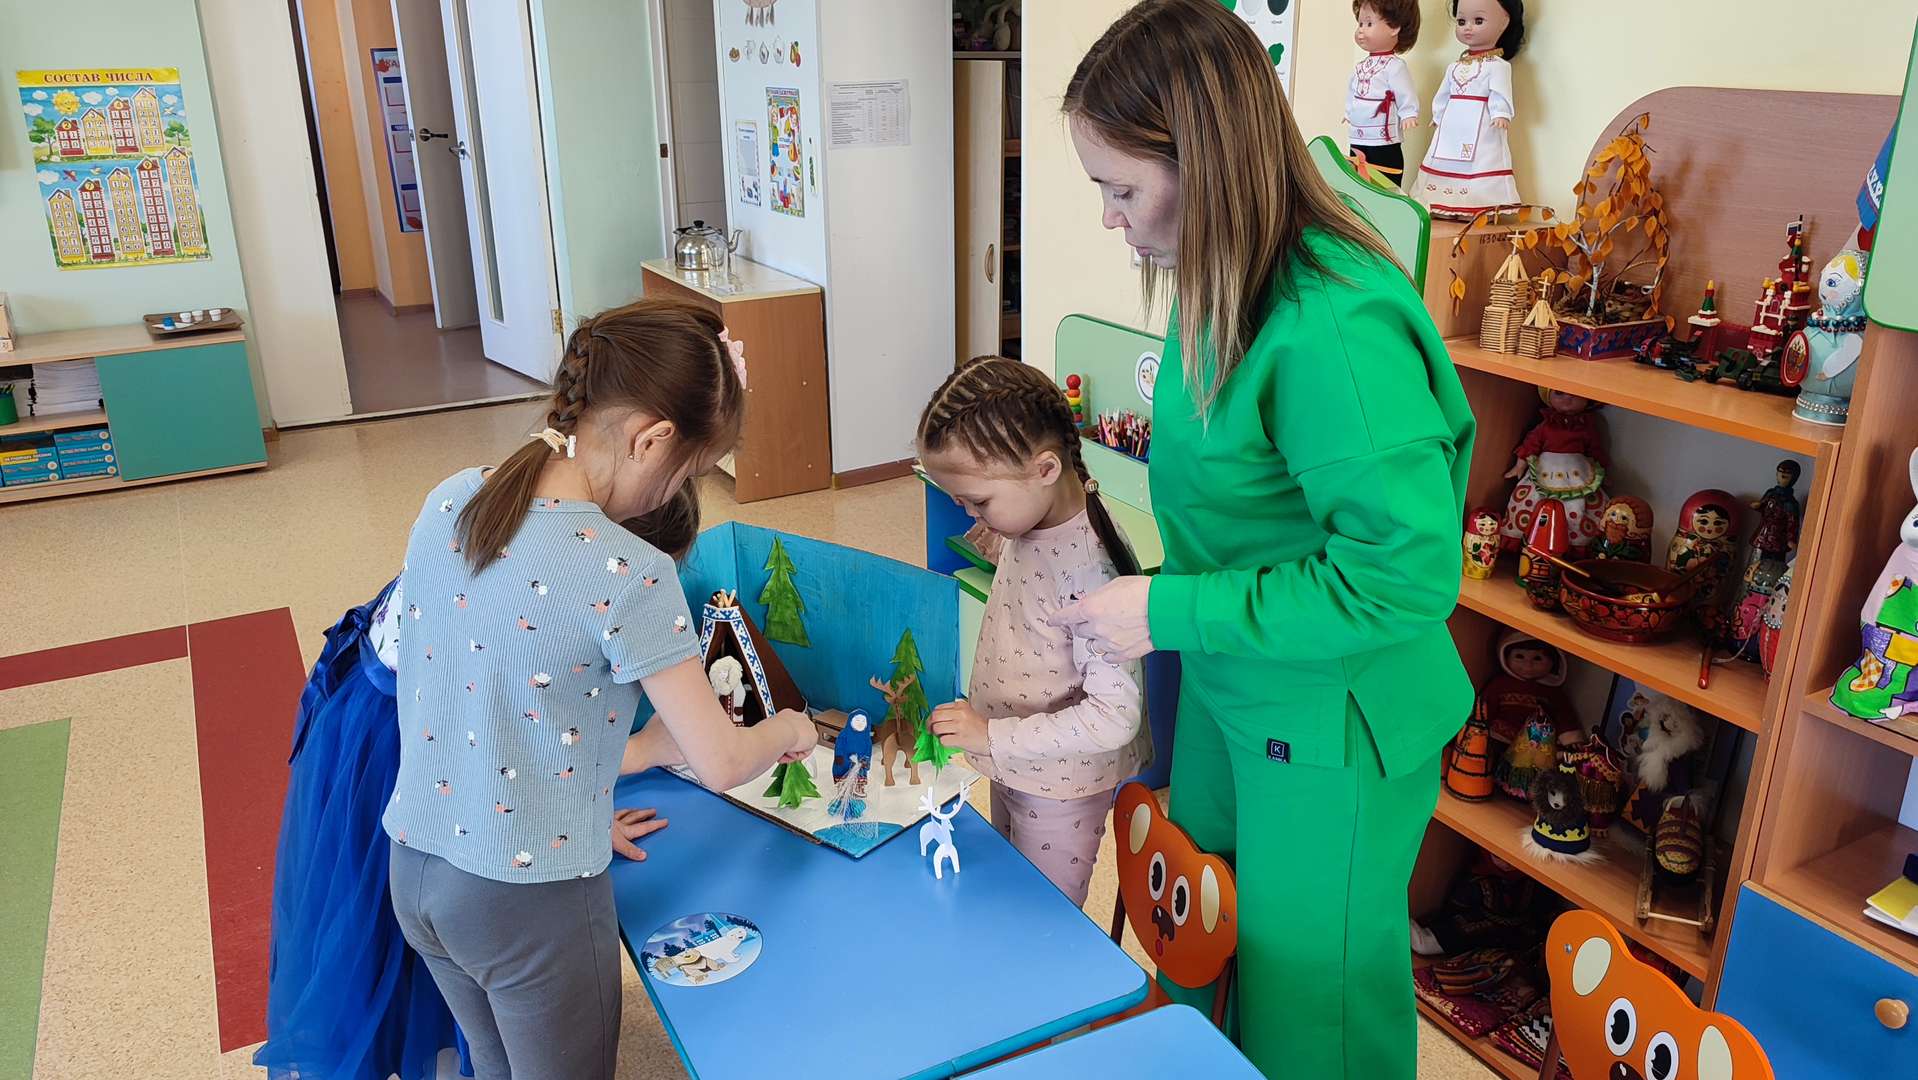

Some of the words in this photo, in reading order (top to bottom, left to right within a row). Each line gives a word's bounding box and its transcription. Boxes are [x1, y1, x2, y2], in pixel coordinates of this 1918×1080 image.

[44, 73, 100, 83] СОСТАВ
[106, 72, 154, 82] ЧИСЛА
[1274, 746, 1281, 754] K
